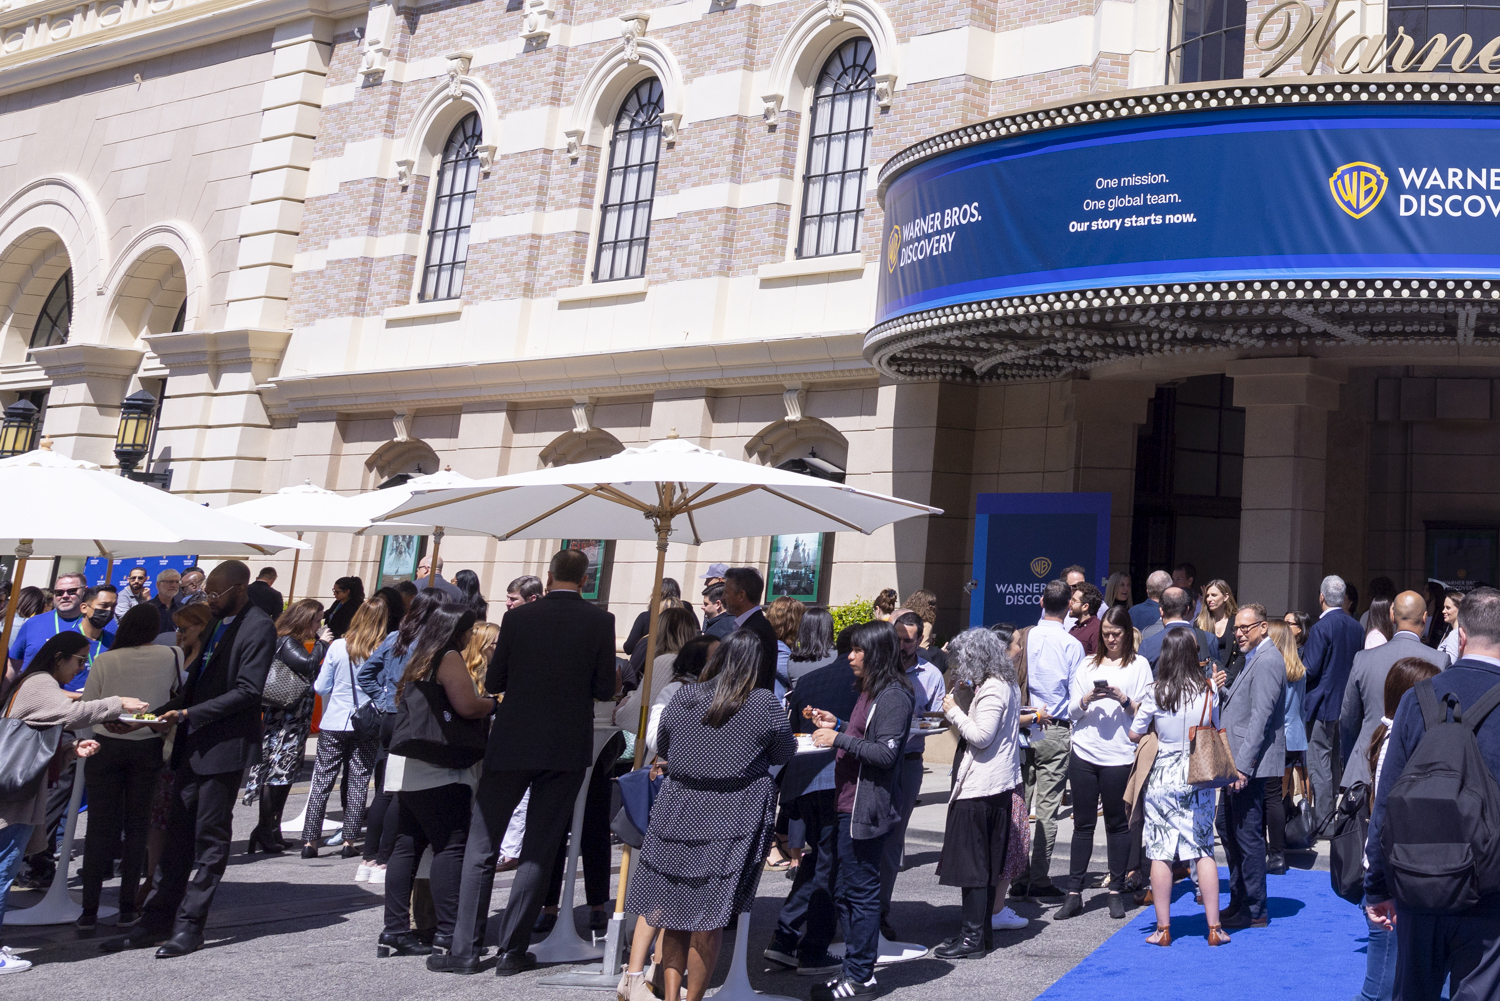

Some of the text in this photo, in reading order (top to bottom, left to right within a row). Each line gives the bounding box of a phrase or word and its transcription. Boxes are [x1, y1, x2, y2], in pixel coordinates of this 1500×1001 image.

[1095, 172, 1170, 190] One mission.
[1335, 170, 1379, 210] WB
[1083, 192, 1182, 212] One global team.
[902, 201, 982, 243] WARNER BROS.
[1069, 212, 1197, 232] Our story starts now.
[900, 231, 957, 267] DISCOVERY
[1033, 560, 1049, 575] WB
